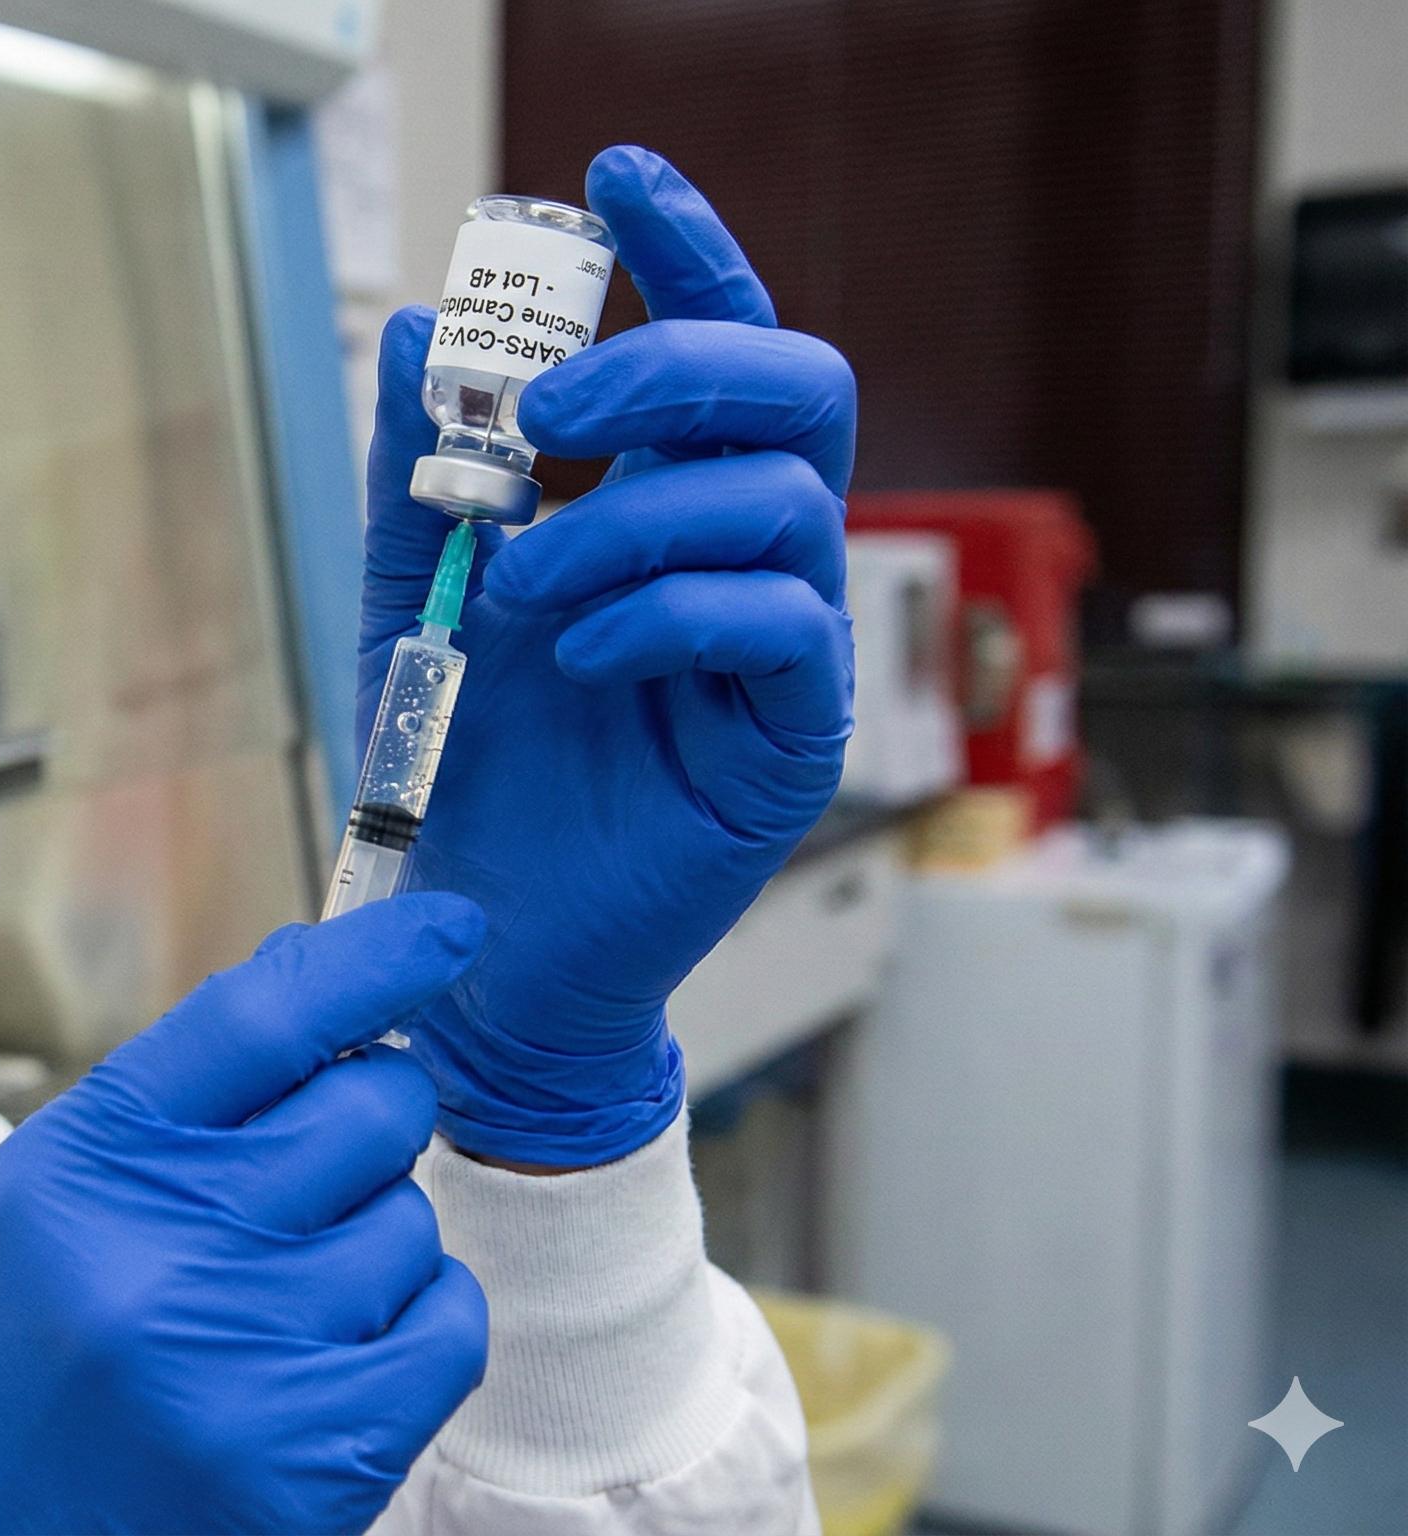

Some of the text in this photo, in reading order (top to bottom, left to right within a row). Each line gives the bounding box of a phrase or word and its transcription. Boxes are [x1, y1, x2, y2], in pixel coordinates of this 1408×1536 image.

[469, 268, 497, 288] 4B
[502, 271, 540, 296] Lot
[439, 325, 568, 367] SARS-CoV-2
